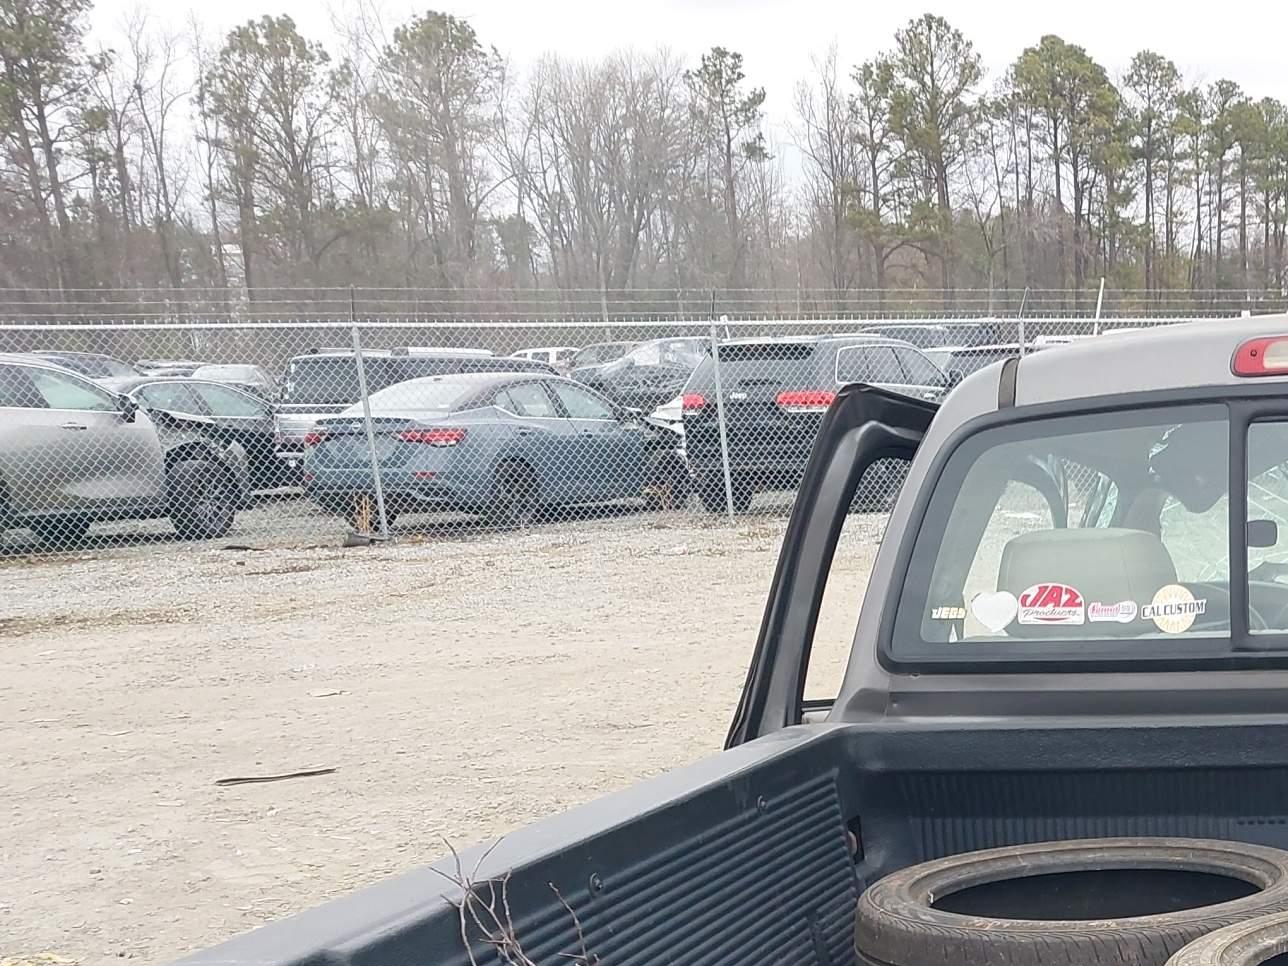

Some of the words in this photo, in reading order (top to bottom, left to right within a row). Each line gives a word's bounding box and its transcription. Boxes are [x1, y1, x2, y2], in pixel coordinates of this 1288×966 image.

[1020, 585, 1082, 608] JAZ
[1142, 605, 1162, 617] CAL
[1164, 601, 1204, 616] CUSTOM
